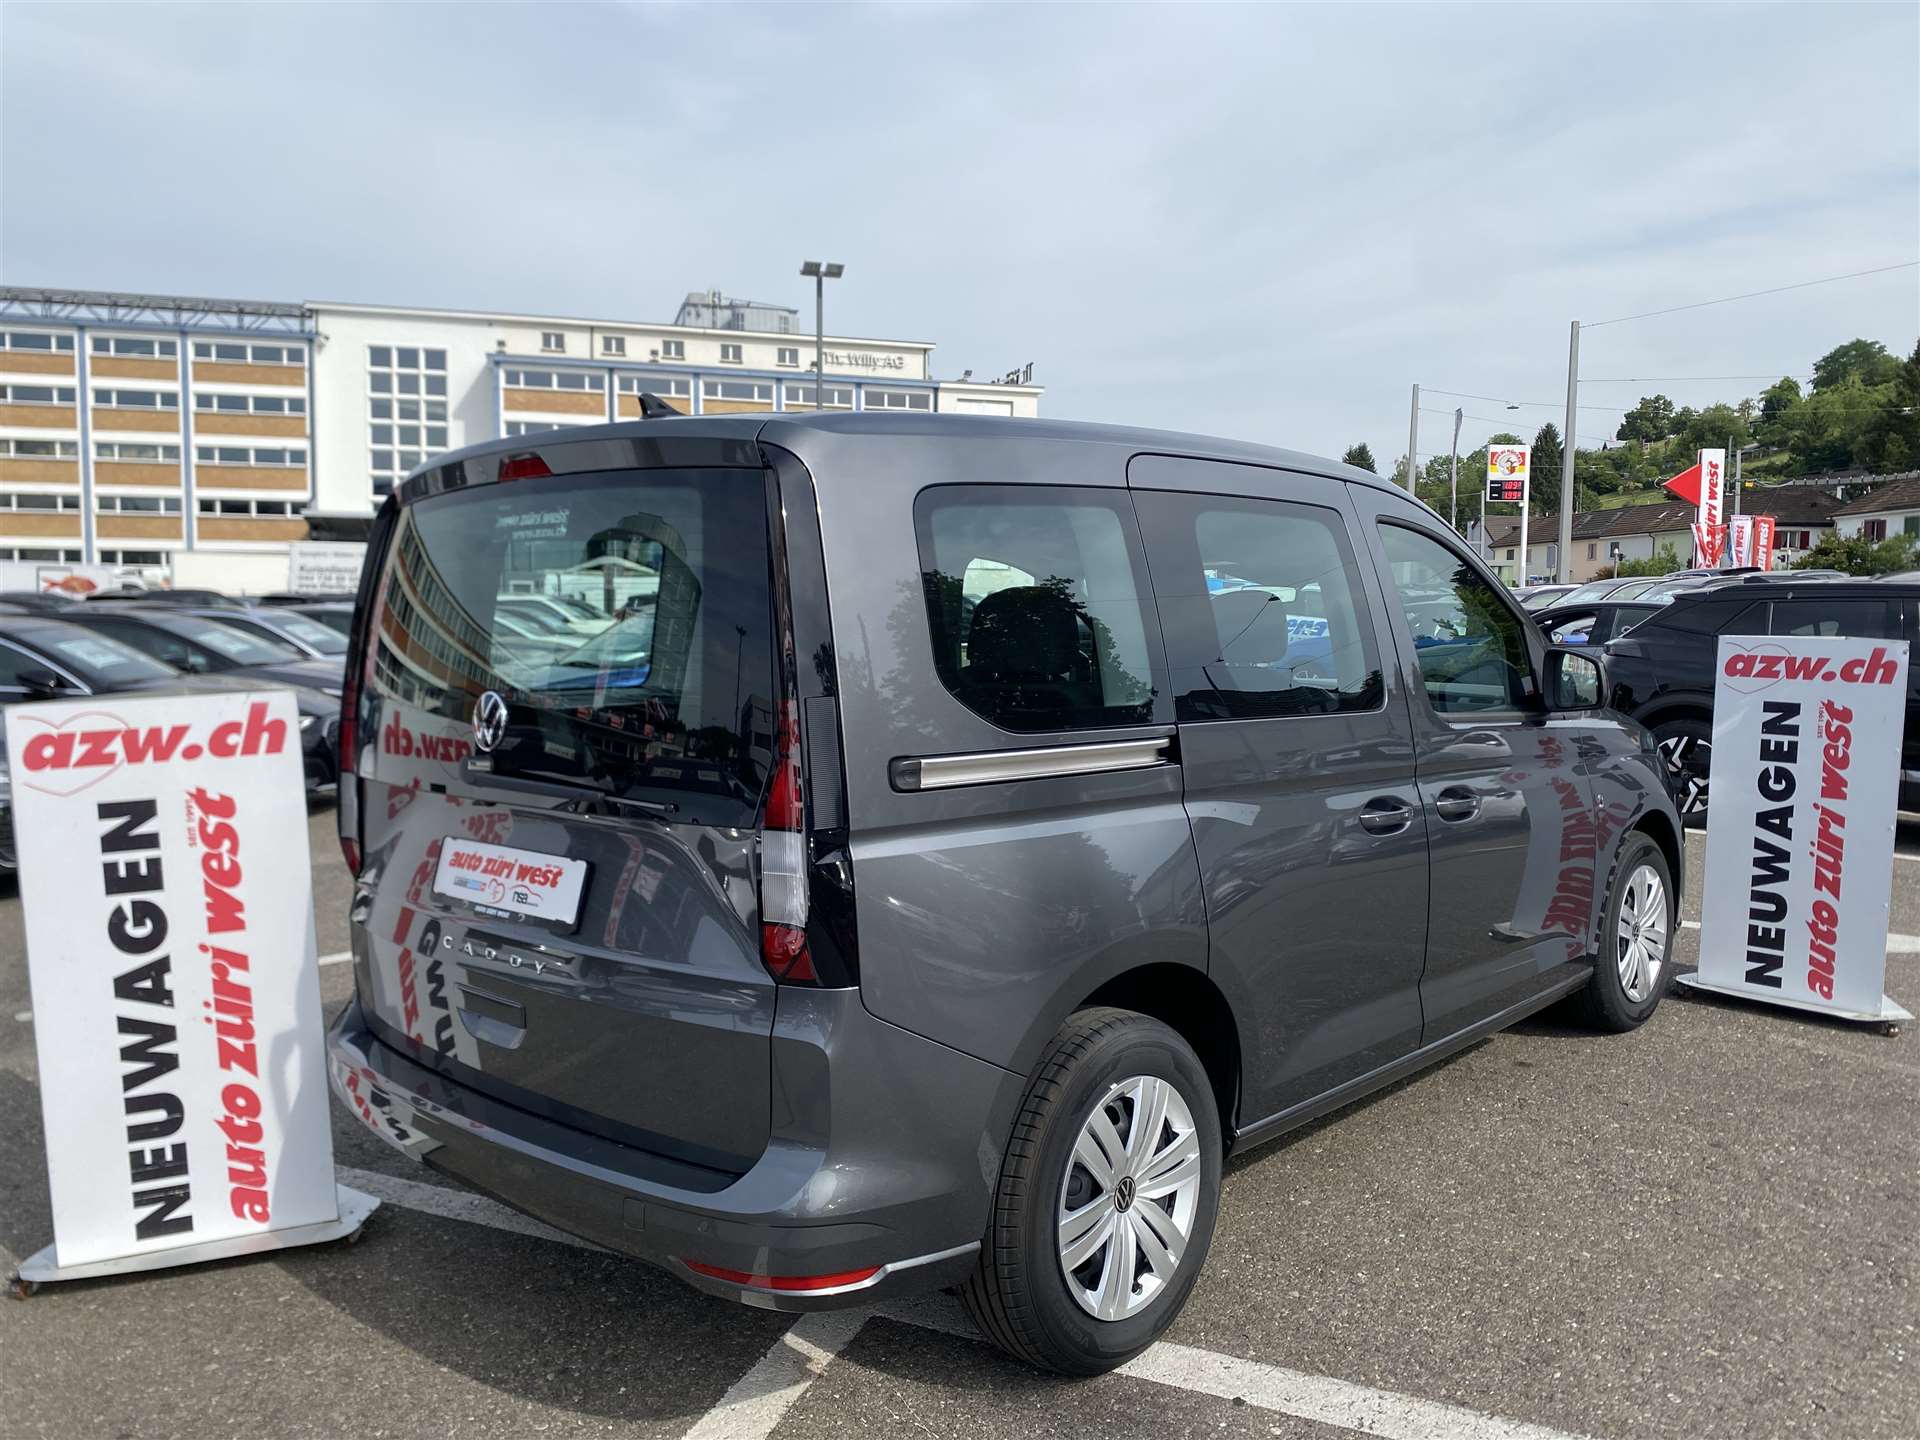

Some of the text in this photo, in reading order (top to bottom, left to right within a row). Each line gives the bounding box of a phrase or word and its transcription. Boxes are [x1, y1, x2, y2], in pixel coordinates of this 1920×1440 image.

[847, 353, 878, 371] Willy
[883, 356, 904, 370] AG
[1708, 461, 1719, 500] west
[1723, 647, 1898, 686] azw.ch
[22, 702, 288, 771] azw.ch
[448, 851, 565, 888] auto züri west
[1744, 700, 1802, 989] NEUWAGEN
[1806, 699, 1855, 1000] auto züri west
[442, 935, 547, 976] CADDY
[97, 798, 194, 1242] NEUWAGEN
[187, 786, 271, 1225] auto züri west
